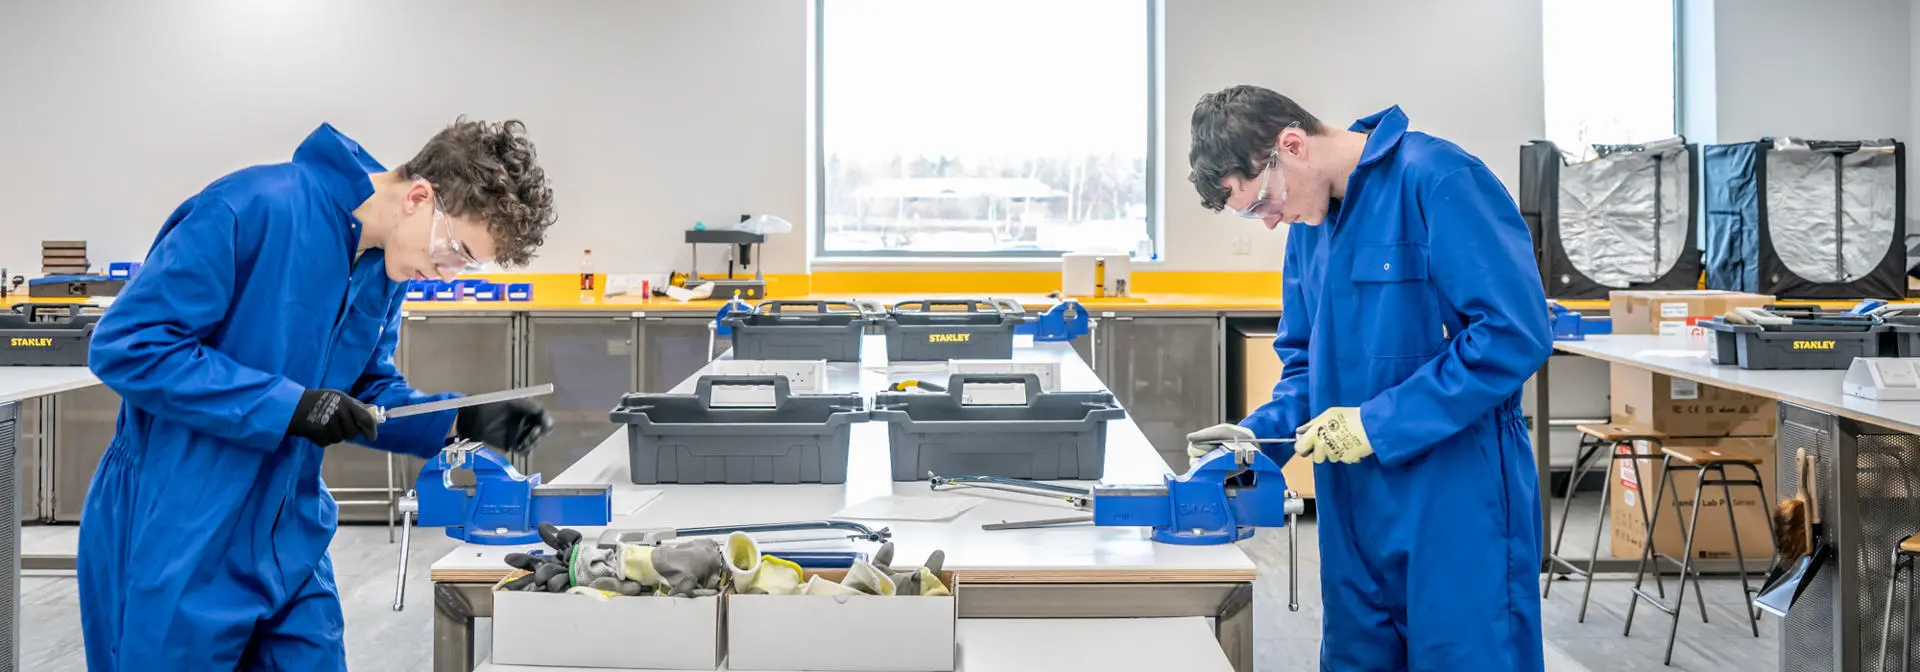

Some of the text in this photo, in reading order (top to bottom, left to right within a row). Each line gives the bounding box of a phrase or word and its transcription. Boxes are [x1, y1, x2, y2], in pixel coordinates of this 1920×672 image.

[11, 337, 53, 346] STANLEY
[929, 333, 970, 342] STANLEY
[1793, 340, 1836, 349] STANLEY
